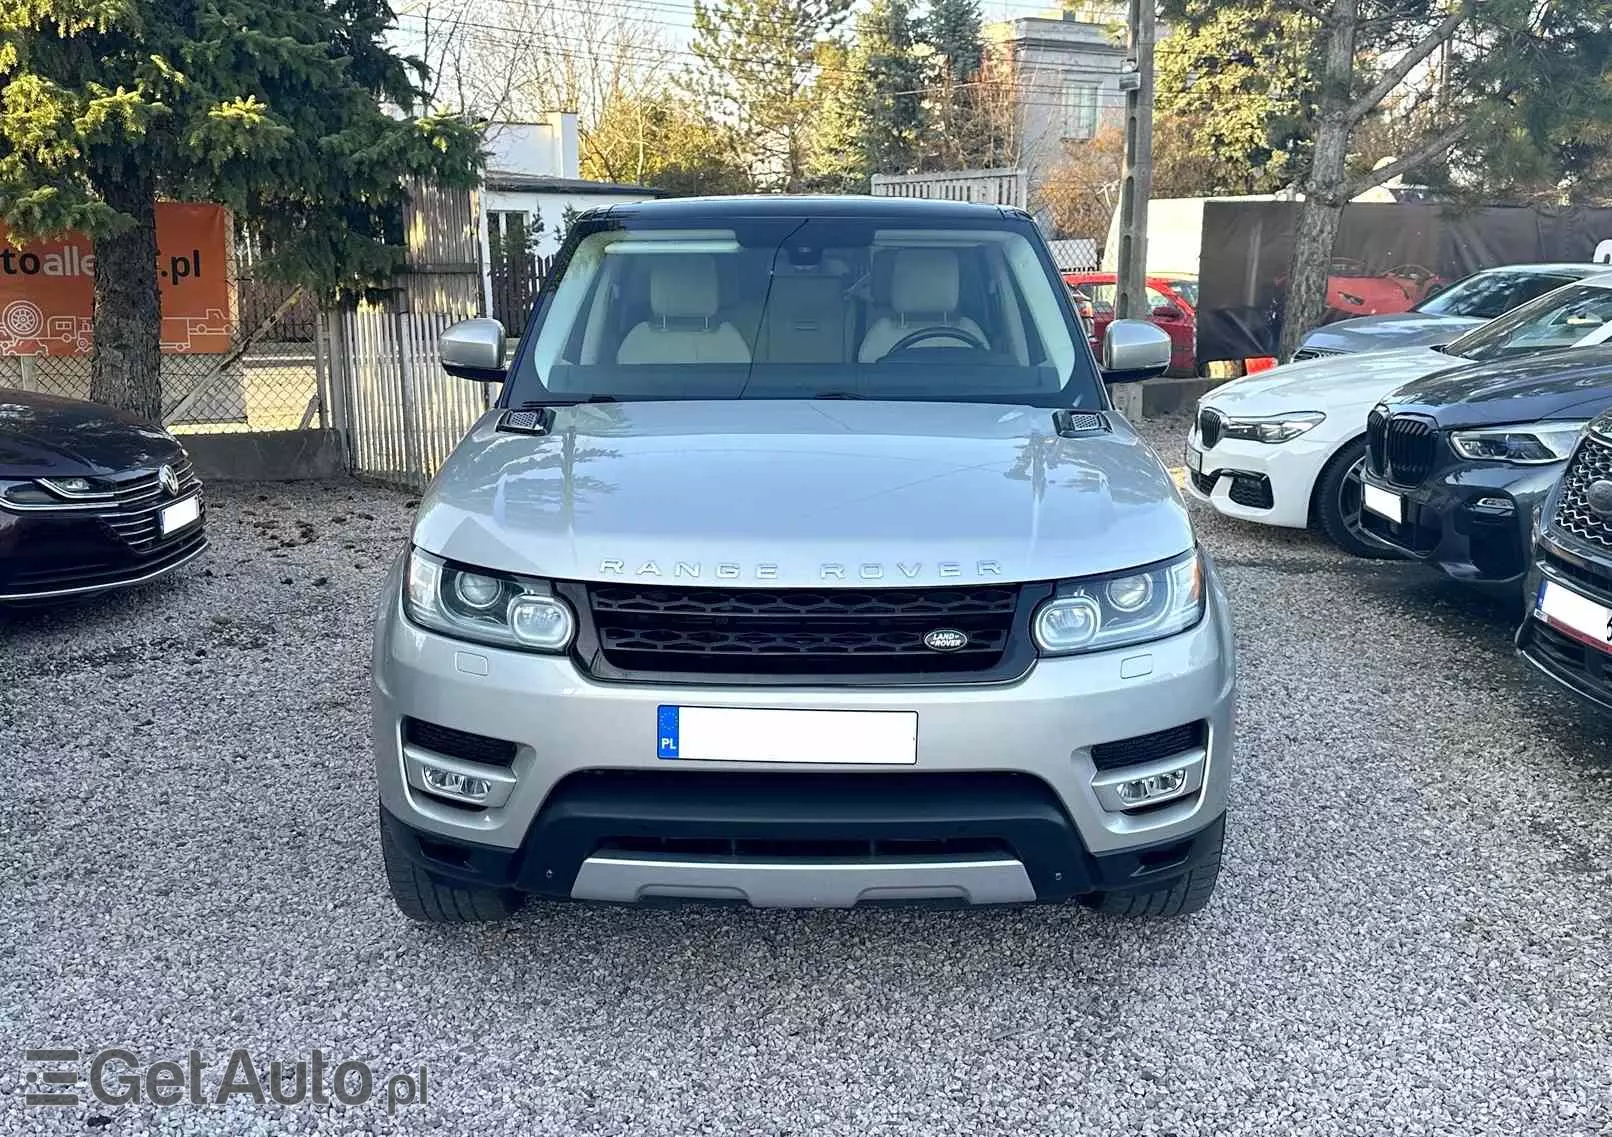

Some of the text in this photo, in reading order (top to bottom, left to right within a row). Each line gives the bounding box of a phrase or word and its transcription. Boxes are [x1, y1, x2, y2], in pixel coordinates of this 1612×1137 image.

[600, 559, 1001, 580] RANGE ROVER
[661, 737, 677, 750] PL
